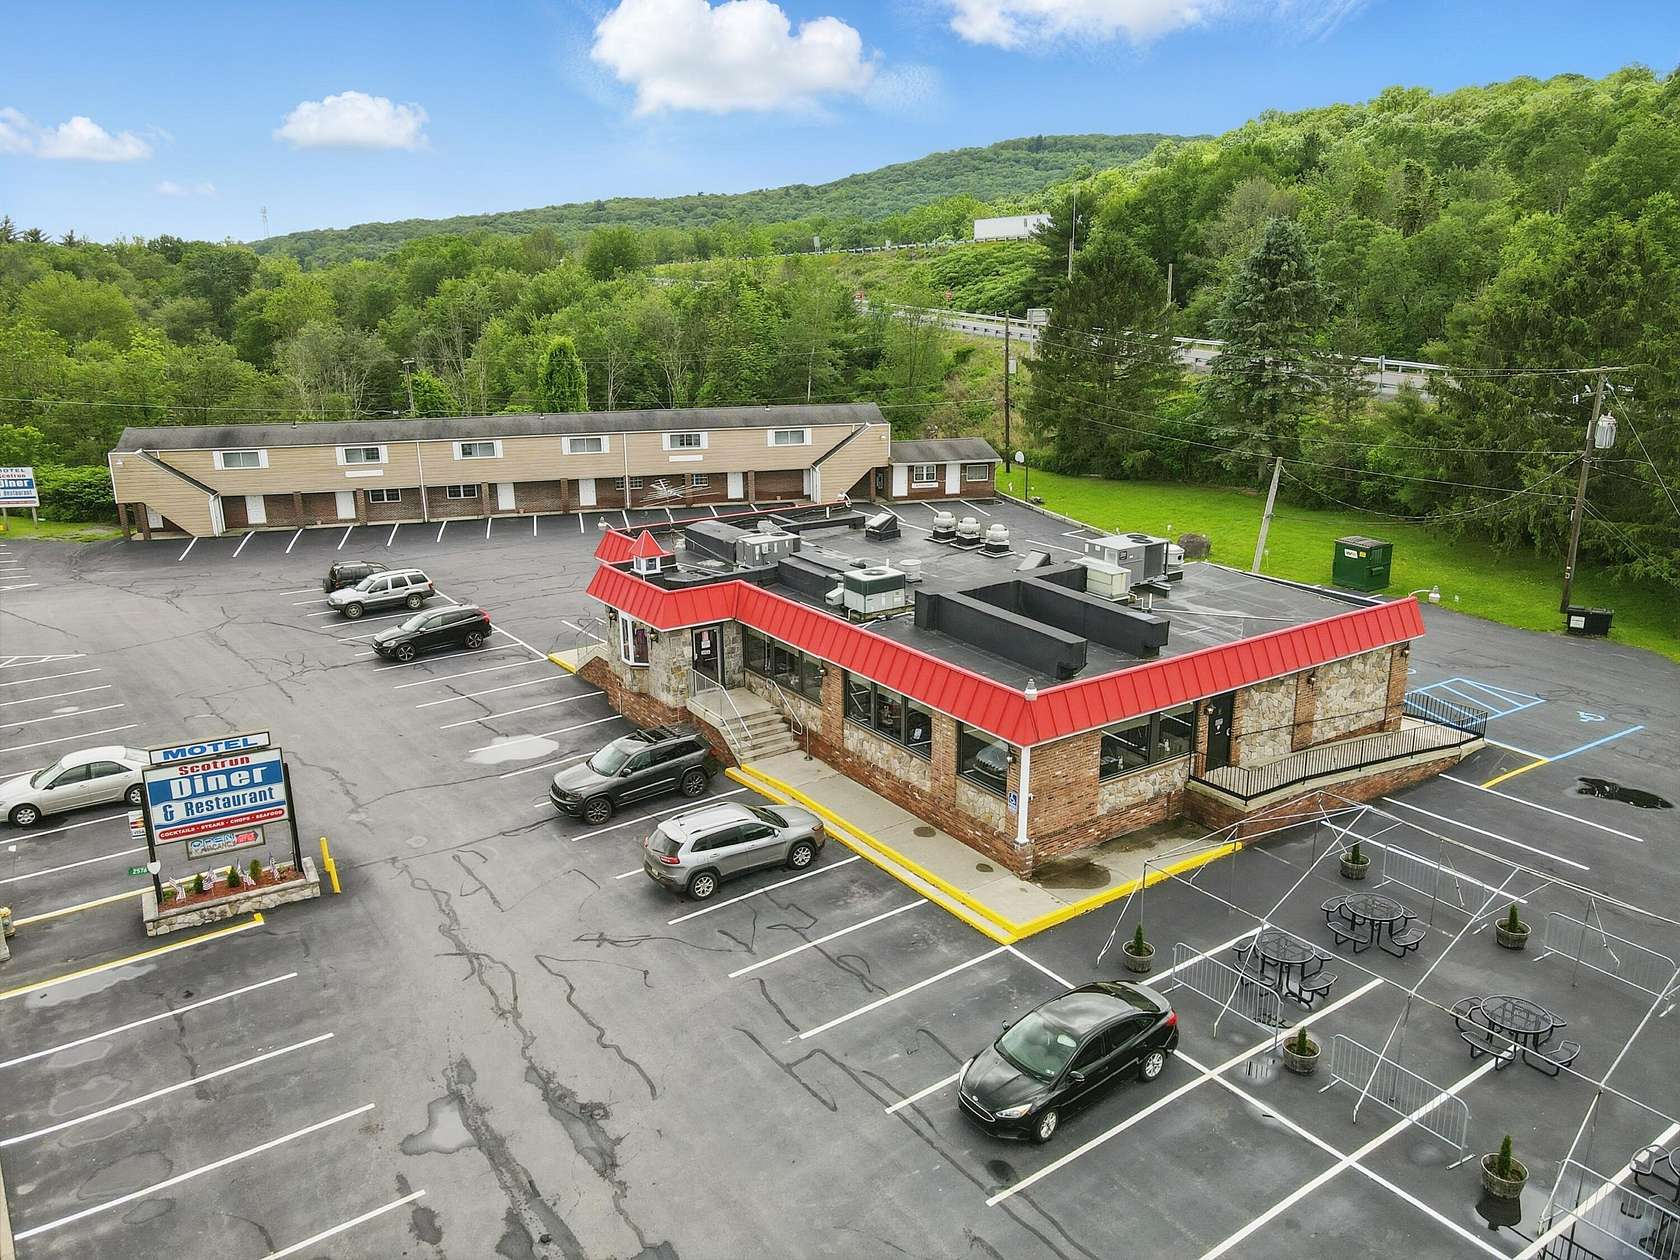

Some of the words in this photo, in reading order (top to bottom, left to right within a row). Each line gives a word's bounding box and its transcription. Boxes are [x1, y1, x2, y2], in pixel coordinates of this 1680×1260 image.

[162, 737, 258, 760] MOTEL
[178, 756, 250, 776] Scotrun
[169, 766, 268, 800] Diner
[162, 804, 175, 822] &
[184, 786, 275, 817] Restaurant
[160, 827, 195, 838] COCKTAILS
[200, 821, 225, 830] STEAKS
[230, 816, 251, 824] CHOPS
[256, 810, 283, 819] SEAFOOD
